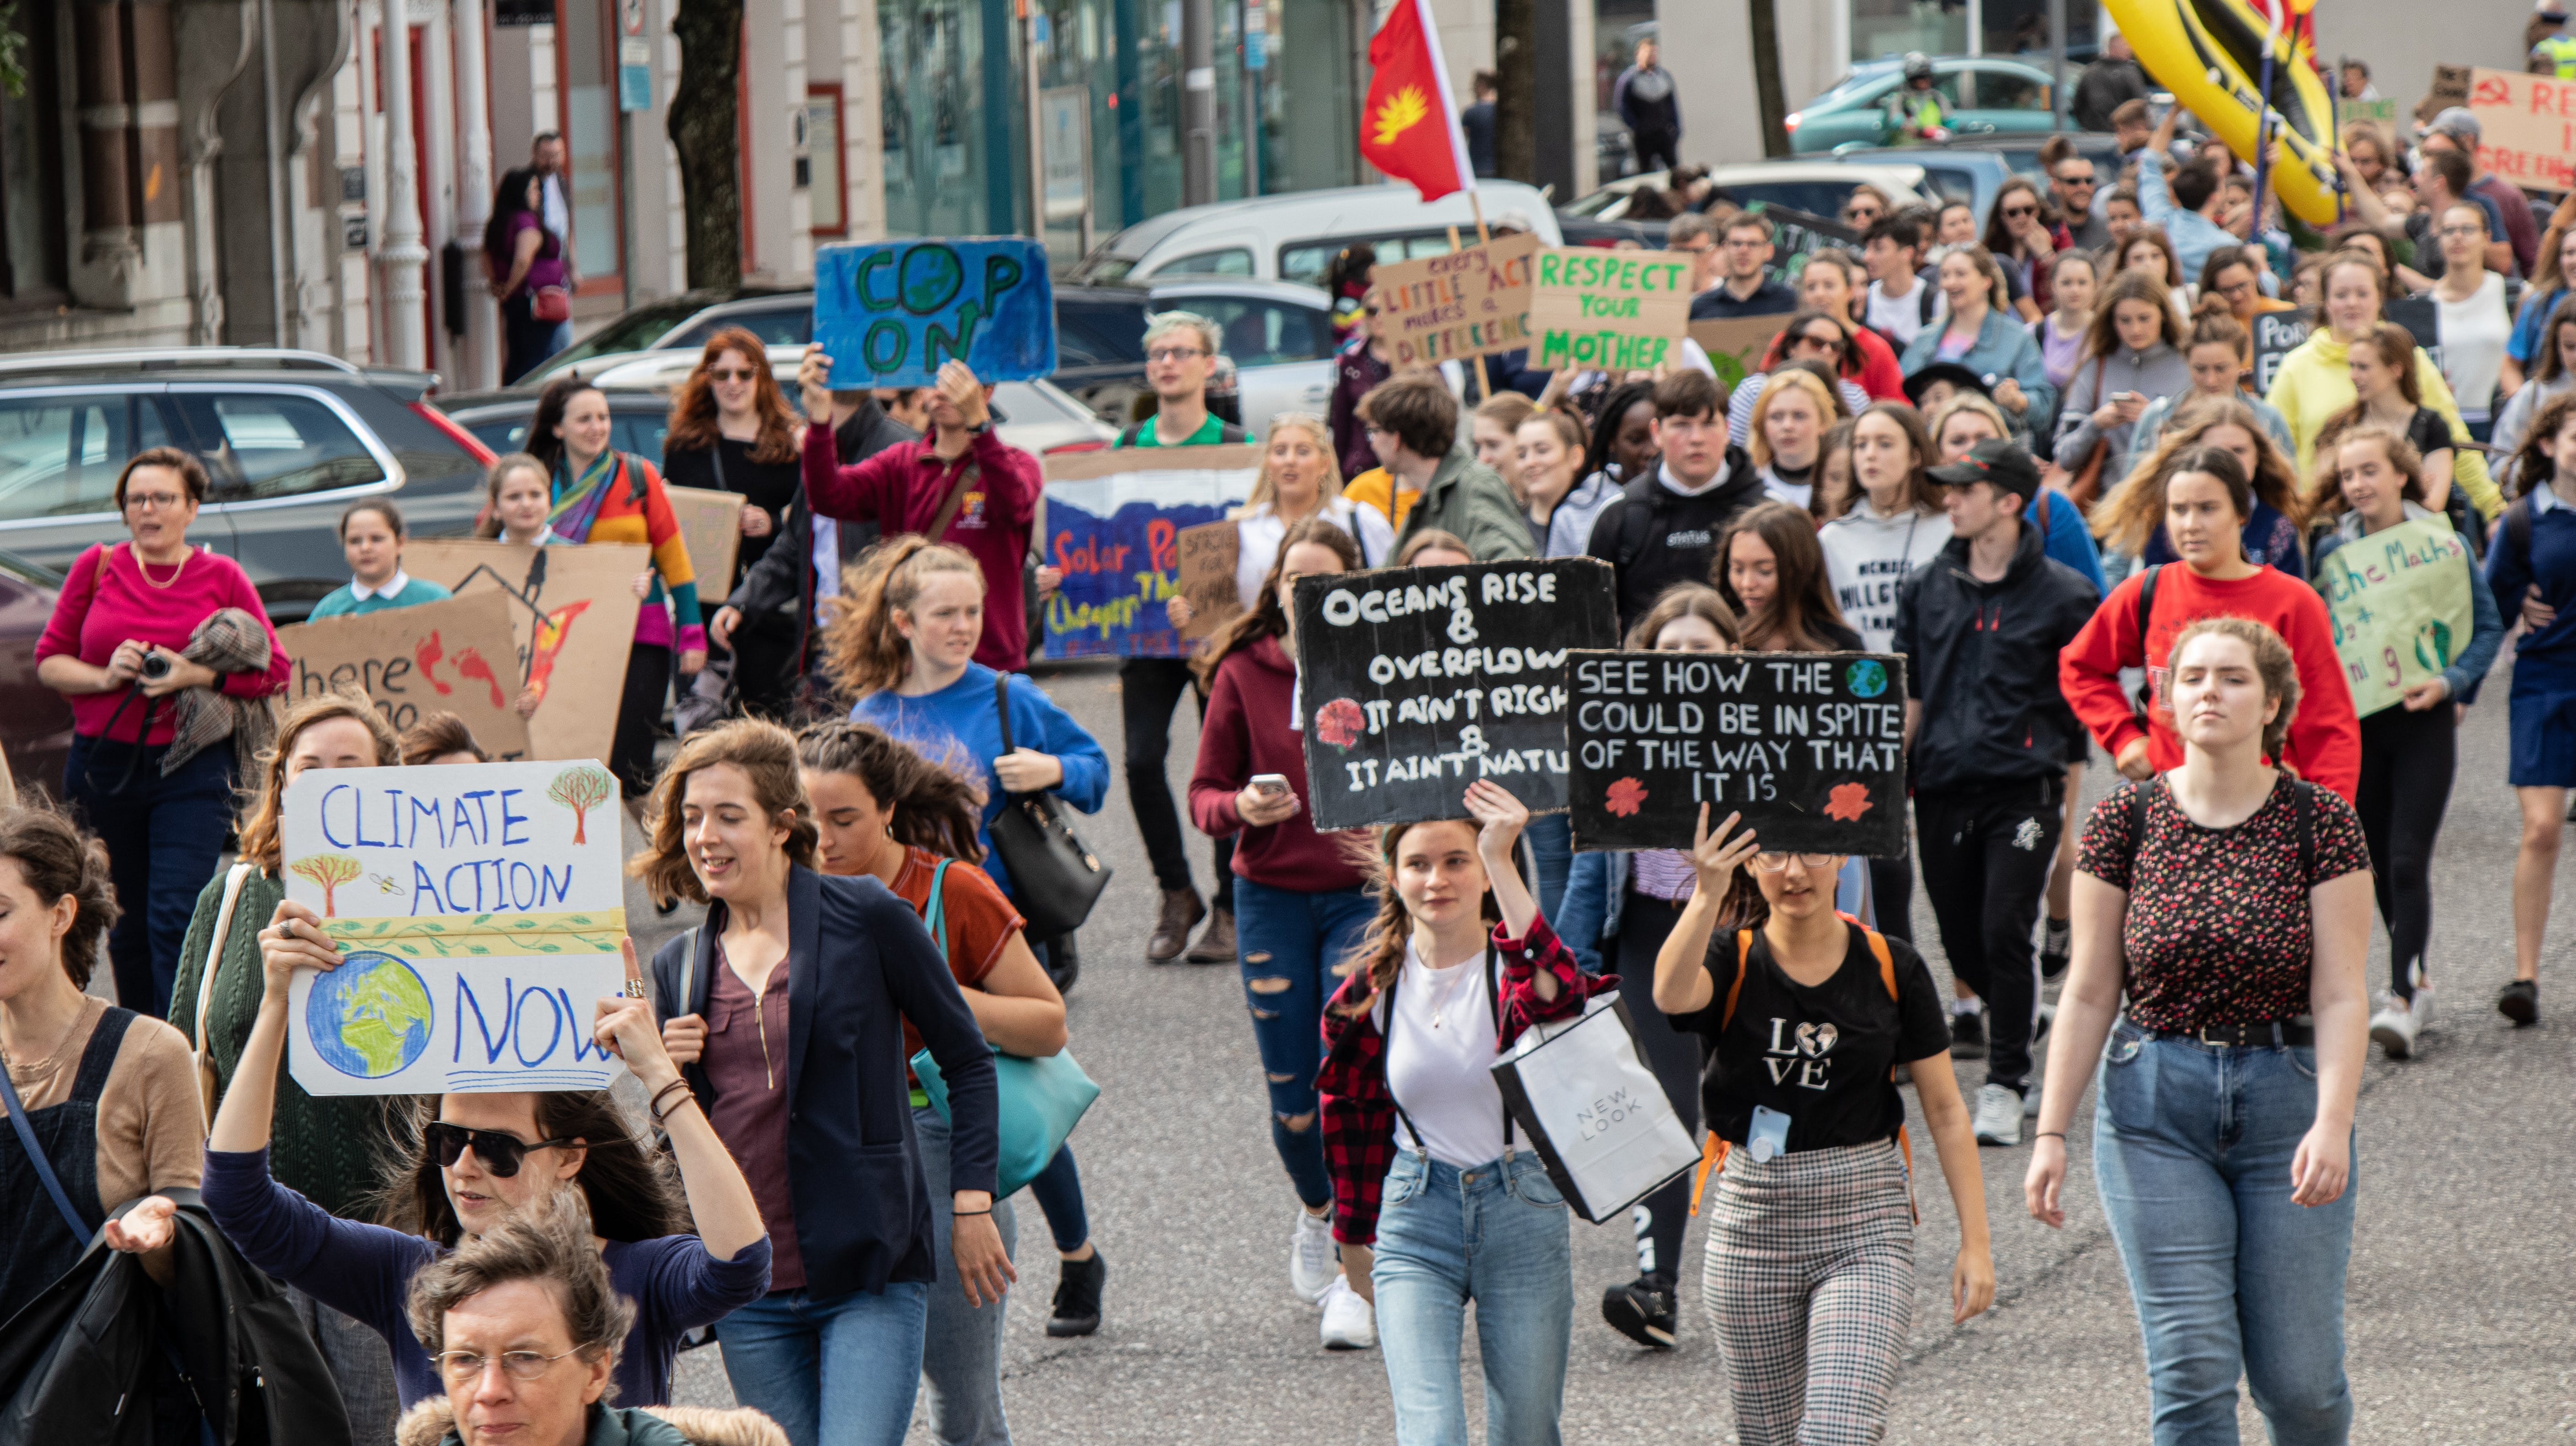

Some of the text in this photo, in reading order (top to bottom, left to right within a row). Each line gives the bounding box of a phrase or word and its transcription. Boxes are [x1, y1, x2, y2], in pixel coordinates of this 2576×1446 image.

[855, 243, 1022, 317] COP
[1383, 253, 1532, 314] LITTLE ACT
[1541, 254, 1686, 291] RESPECT
[1580, 293, 1640, 317] YOUR
[862, 298, 981, 374] ON
[1542, 328, 1669, 369] MOTHER
[1050, 529, 1131, 576] Solar
[1322, 572, 1556, 627] OCEANS RISE
[1446, 607, 1479, 644] &
[1368, 646, 1568, 685] OVERFLOW
[1577, 661, 1834, 695] SEE HOW THE
[1363, 699, 1392, 735] IT
[1397, 688, 1483, 724] AIN'T
[1578, 700, 1900, 738] COULD BE IN SPITE
[1459, 724, 1490, 756] &
[1580, 739, 1901, 772] OF THE WAY THAT
[1345, 758, 1379, 791] IT
[1693, 771, 1777, 803] IT IS
[321, 784, 529, 849] CLIMATE
[411, 857, 572, 916] ACTION
[1761, 1056, 1831, 1091] VE
[1576, 1085, 1627, 1124] NEW
[1580, 1097, 1643, 1142] LOOK
